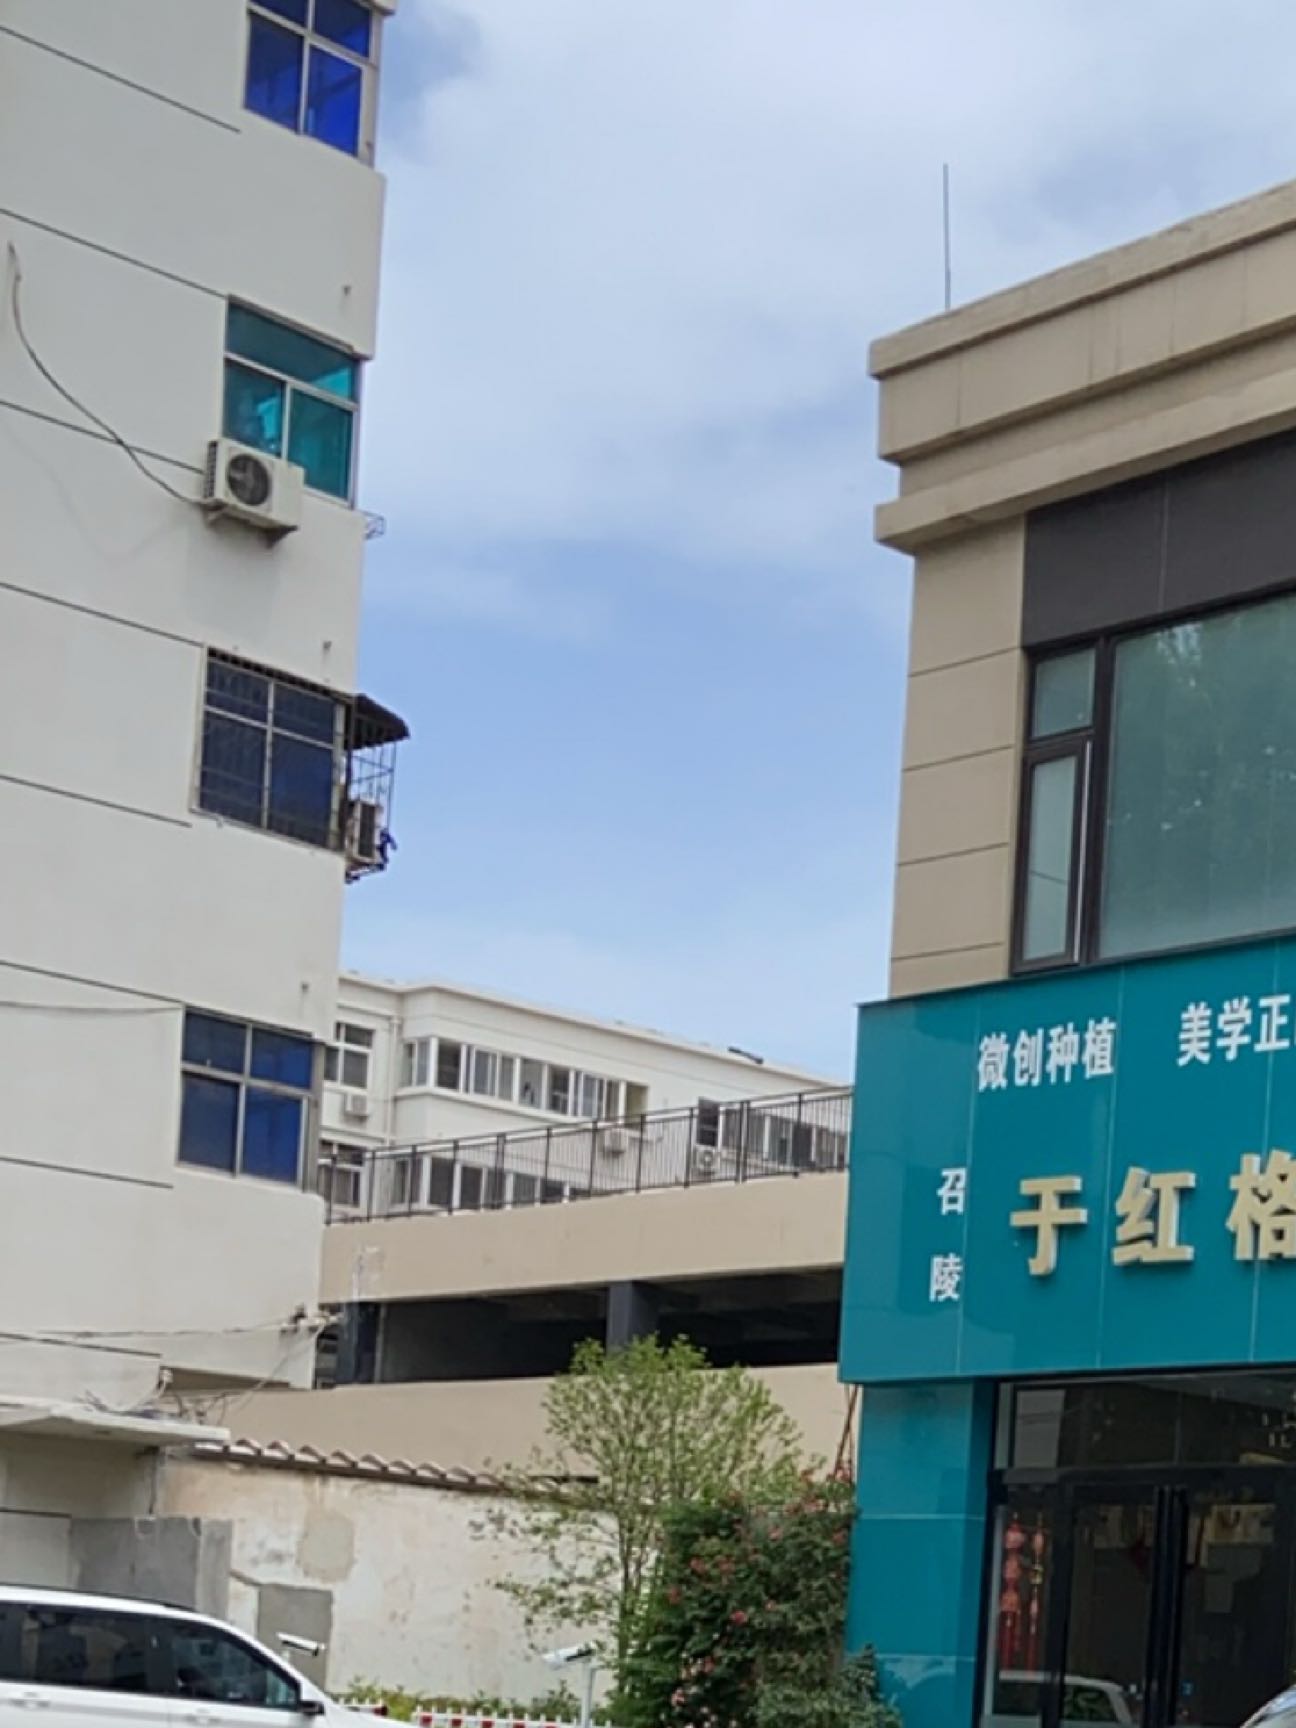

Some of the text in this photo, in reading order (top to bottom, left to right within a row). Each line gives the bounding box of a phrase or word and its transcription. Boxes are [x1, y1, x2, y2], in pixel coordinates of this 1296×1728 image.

[977, 1017, 1117, 1092] 微创种植
[929, 1166, 968, 1303] 召陵
